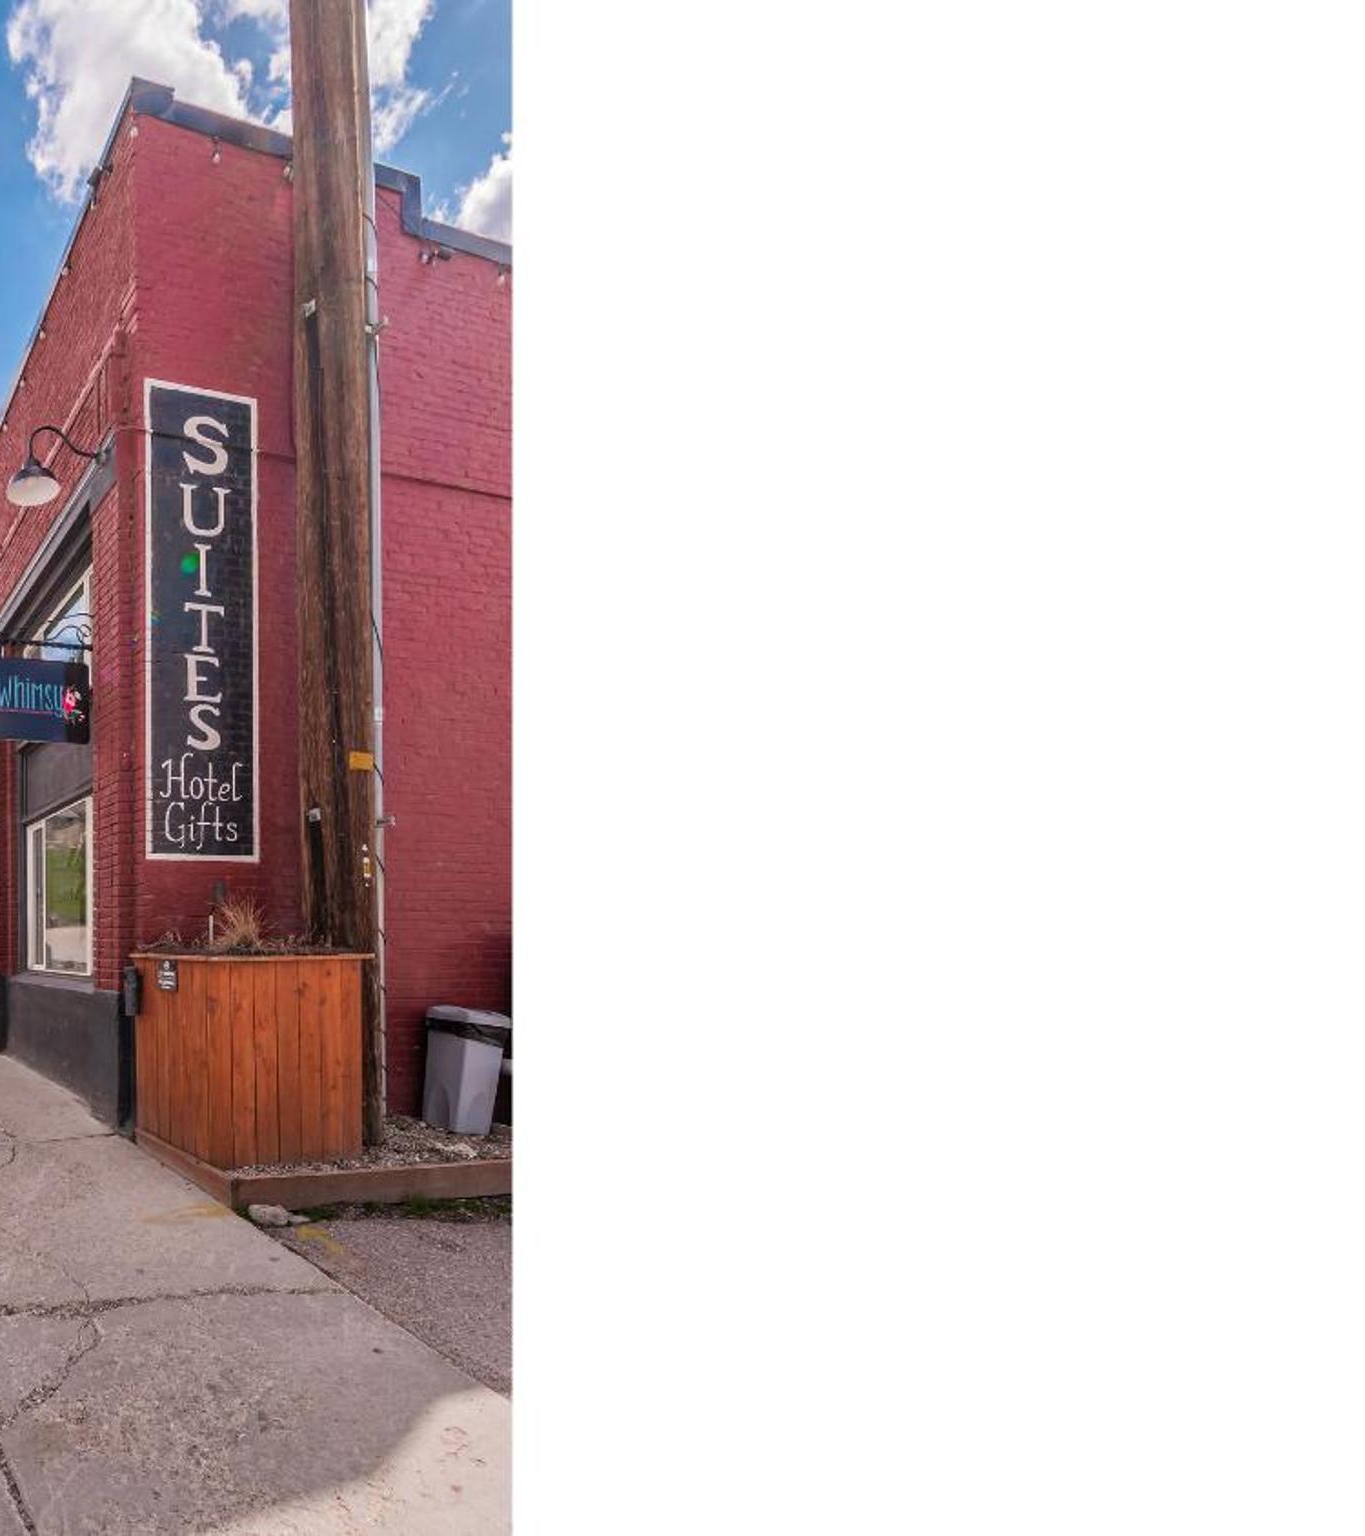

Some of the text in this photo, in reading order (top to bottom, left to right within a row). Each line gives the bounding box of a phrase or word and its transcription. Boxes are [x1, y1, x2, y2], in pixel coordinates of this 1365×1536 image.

[179, 415, 232, 751] SUITES
[159, 752, 243, 802] Hotel
[165, 801, 238, 850] Gifts
